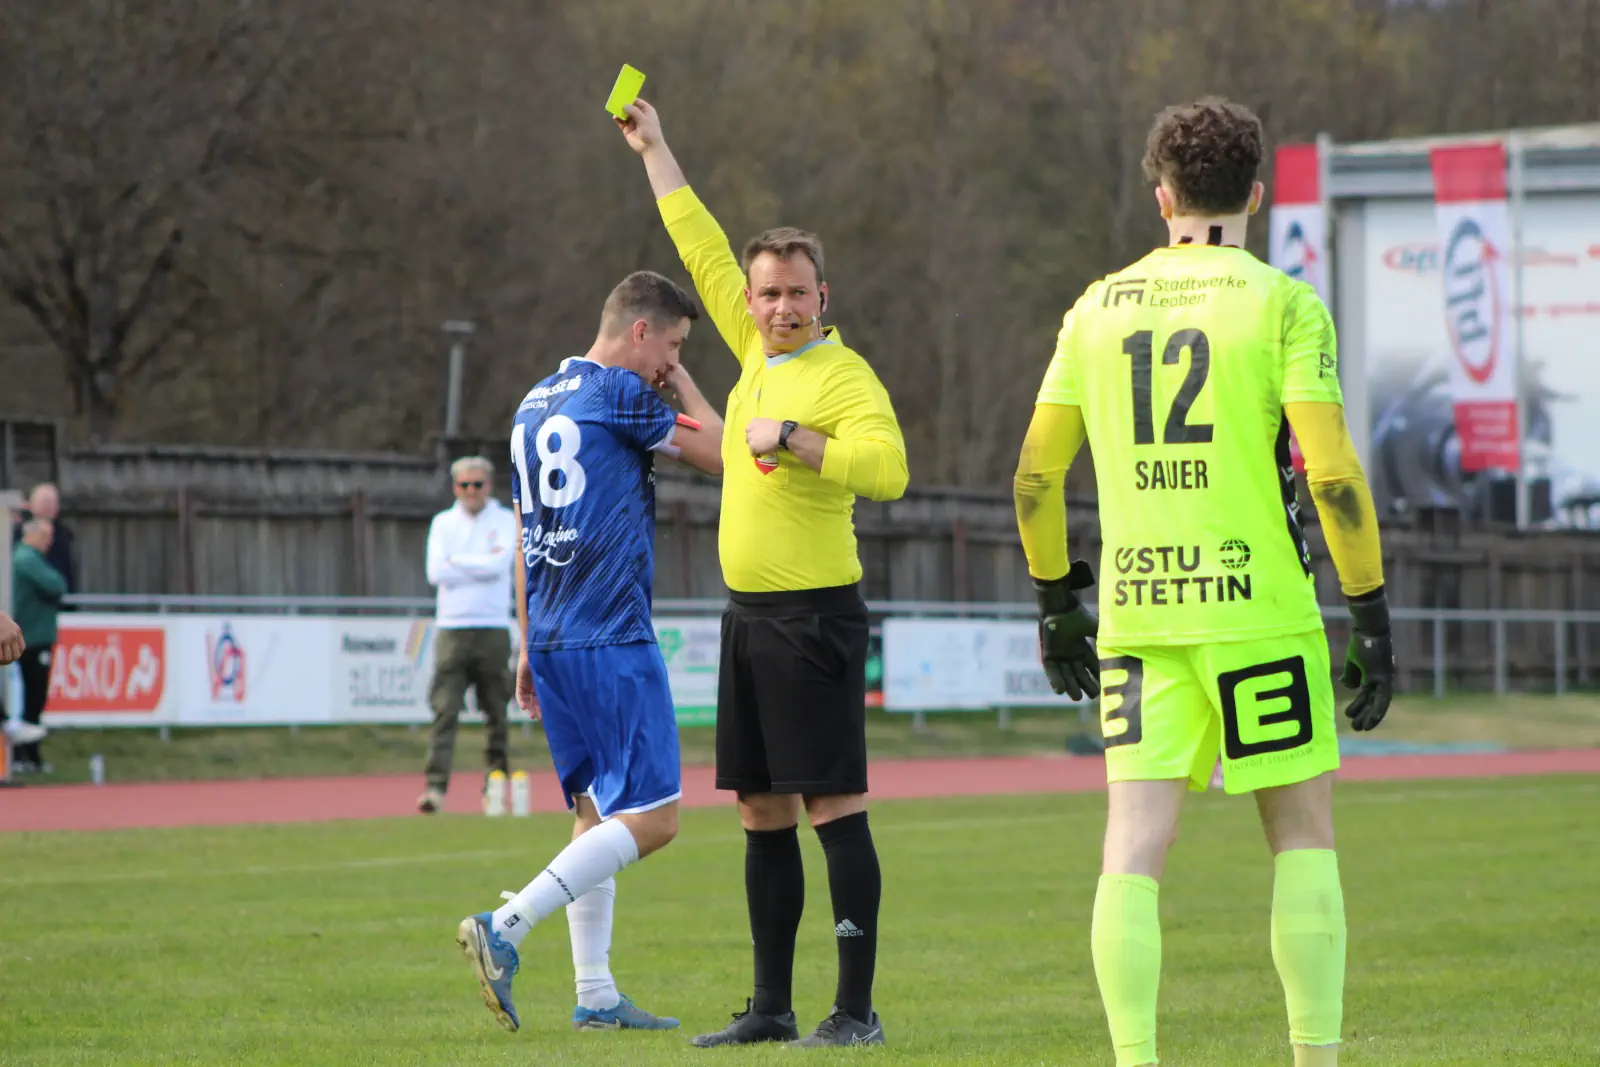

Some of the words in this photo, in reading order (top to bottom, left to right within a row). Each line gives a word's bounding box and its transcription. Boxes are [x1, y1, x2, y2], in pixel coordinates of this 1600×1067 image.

[1153, 275, 1247, 292] Stadtwerke
[1150, 292, 1206, 308] Leoben
[1122, 328, 1213, 445] 12
[510, 414, 586, 515] 18
[1135, 460, 1209, 490] SAUER
[1114, 574, 1252, 606] STETTIN
[50, 633, 123, 701] ASKÖ
